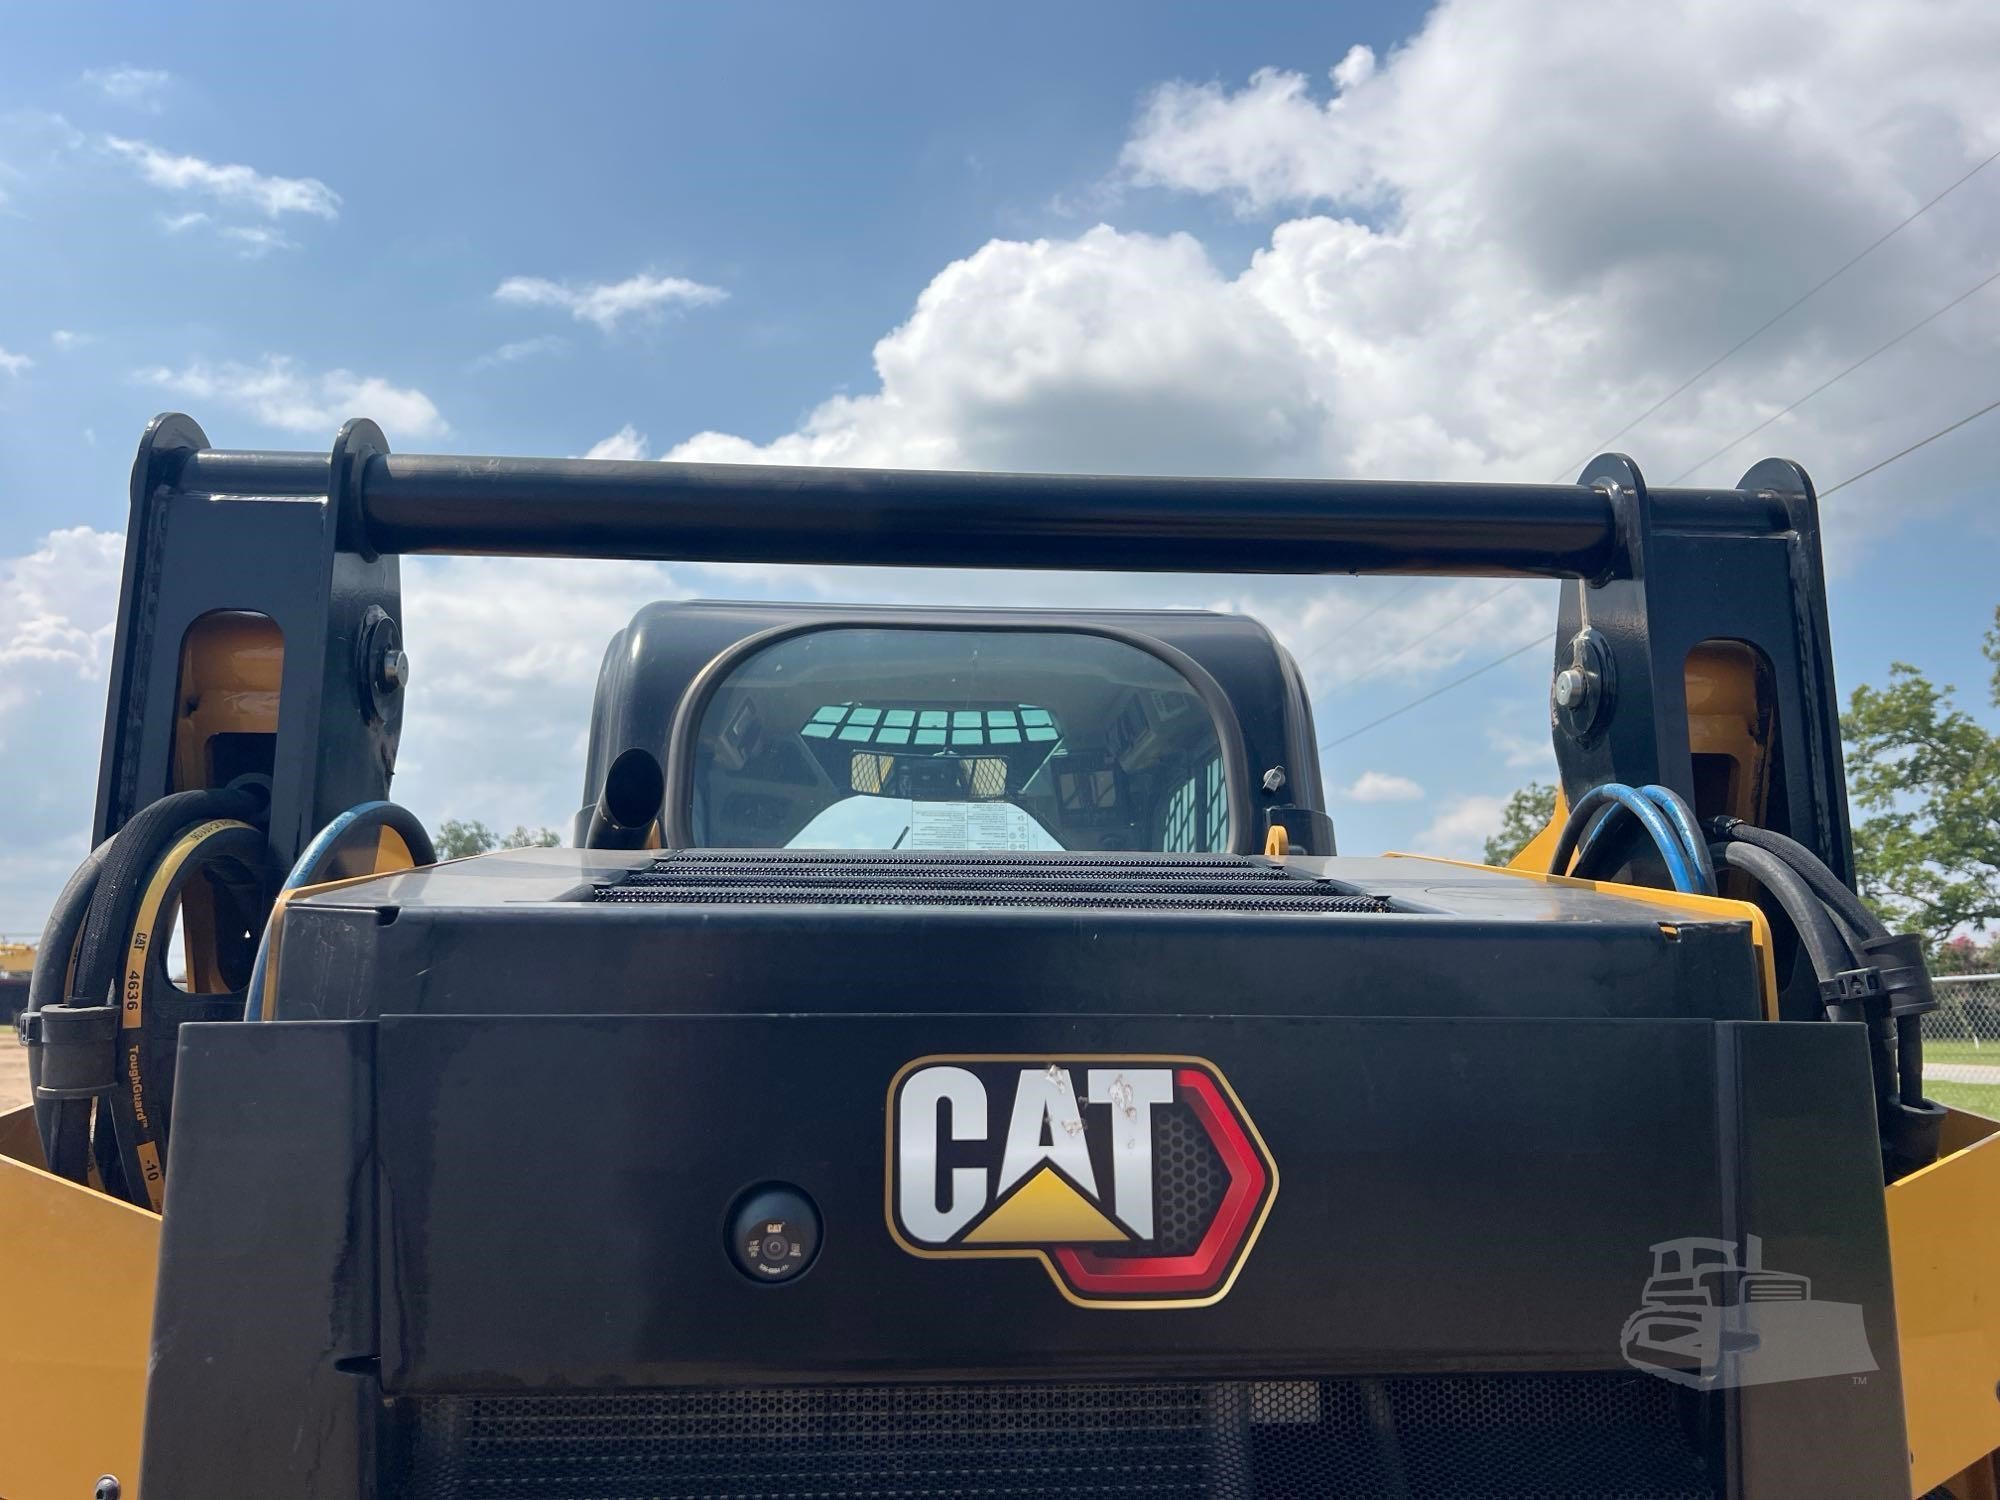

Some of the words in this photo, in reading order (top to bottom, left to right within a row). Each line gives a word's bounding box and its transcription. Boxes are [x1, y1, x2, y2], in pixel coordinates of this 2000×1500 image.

[133, 932, 147, 951] CAT
[127, 970, 140, 1010] 4636
[900, 1066, 1174, 1243] CAT
[767, 1223, 783, 1233] CAT
